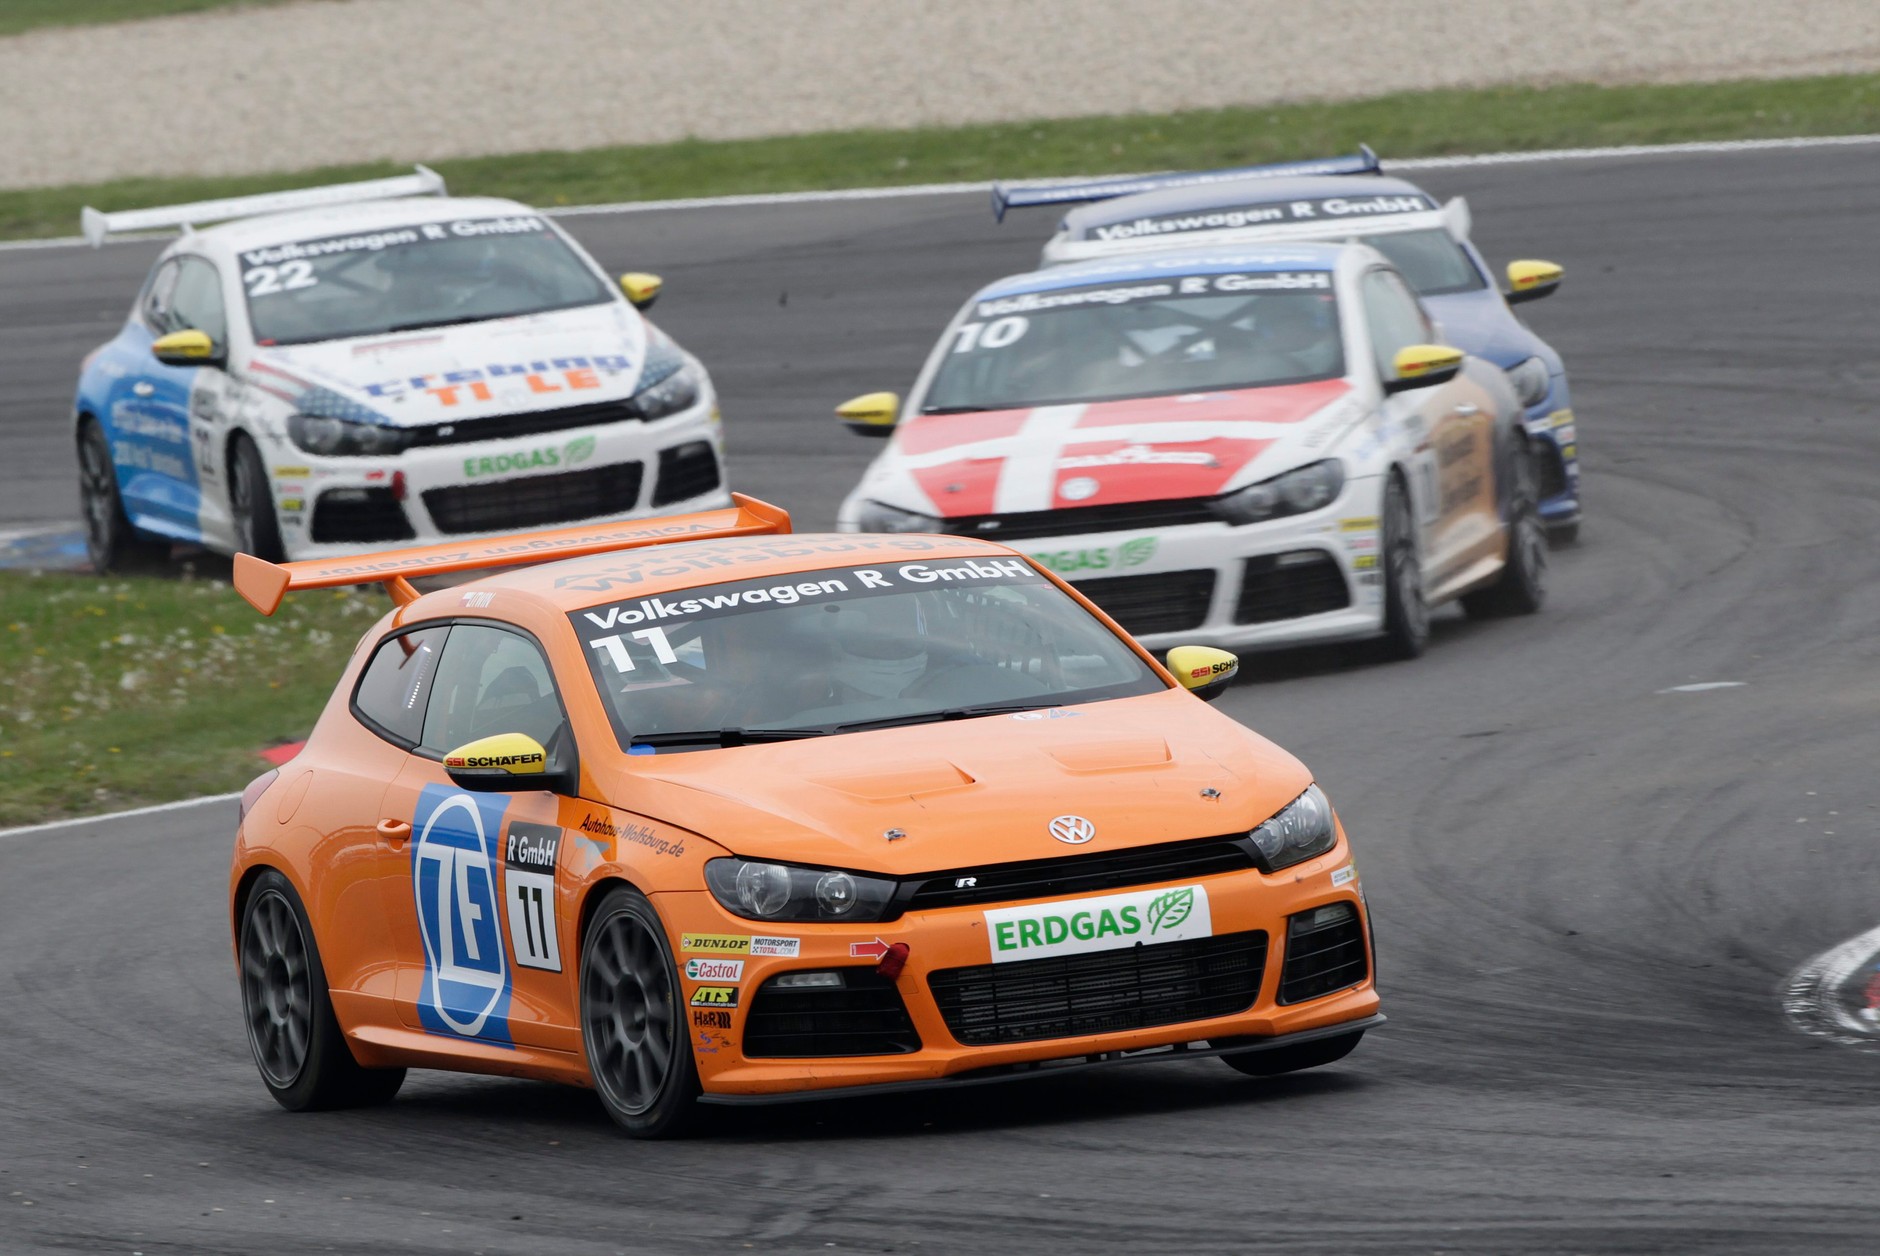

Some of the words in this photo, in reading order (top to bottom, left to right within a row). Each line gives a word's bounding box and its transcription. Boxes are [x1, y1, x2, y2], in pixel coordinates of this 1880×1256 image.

[1097, 208, 1283, 240] Volkswagen
[1290, 200, 1316, 217] R
[1321, 196, 1424, 215] GmbH
[244, 231, 419, 266] Volkswagen
[421, 223, 448, 240] R
[450, 217, 545, 236] GmbH
[244, 258, 321, 298] 22
[976, 283, 1173, 318] Volkswagen
[1179, 276, 1209, 294] R
[1214, 273, 1331, 291] GmbH
[953, 315, 1030, 354] 10
[463, 447, 561, 478] ERDGAS
[584, 578, 849, 630] Volkswagen
[853, 569, 894, 589] R
[898, 560, 1035, 584] GmbH
[589, 626, 678, 674] 11
[1191, 666, 1211, 679] SSI
[446, 757, 465, 767] SSI
[467, 753, 542, 767] SCHÄFER
[507, 834, 516, 862] R
[518, 836, 556, 867] GmbH
[579, 813, 685, 858] Autohaus-Wolfsburg.de
[518, 885, 549, 959] 11
[995, 905, 1141, 952] ERDGAS
[693, 938, 748, 949] DUNLOP
[754, 938, 798, 948] MOTORSPORT
[699, 962, 739, 979] Castrol
[691, 987, 734, 1003] ATS
[694, 1011, 716, 1027] H&R
